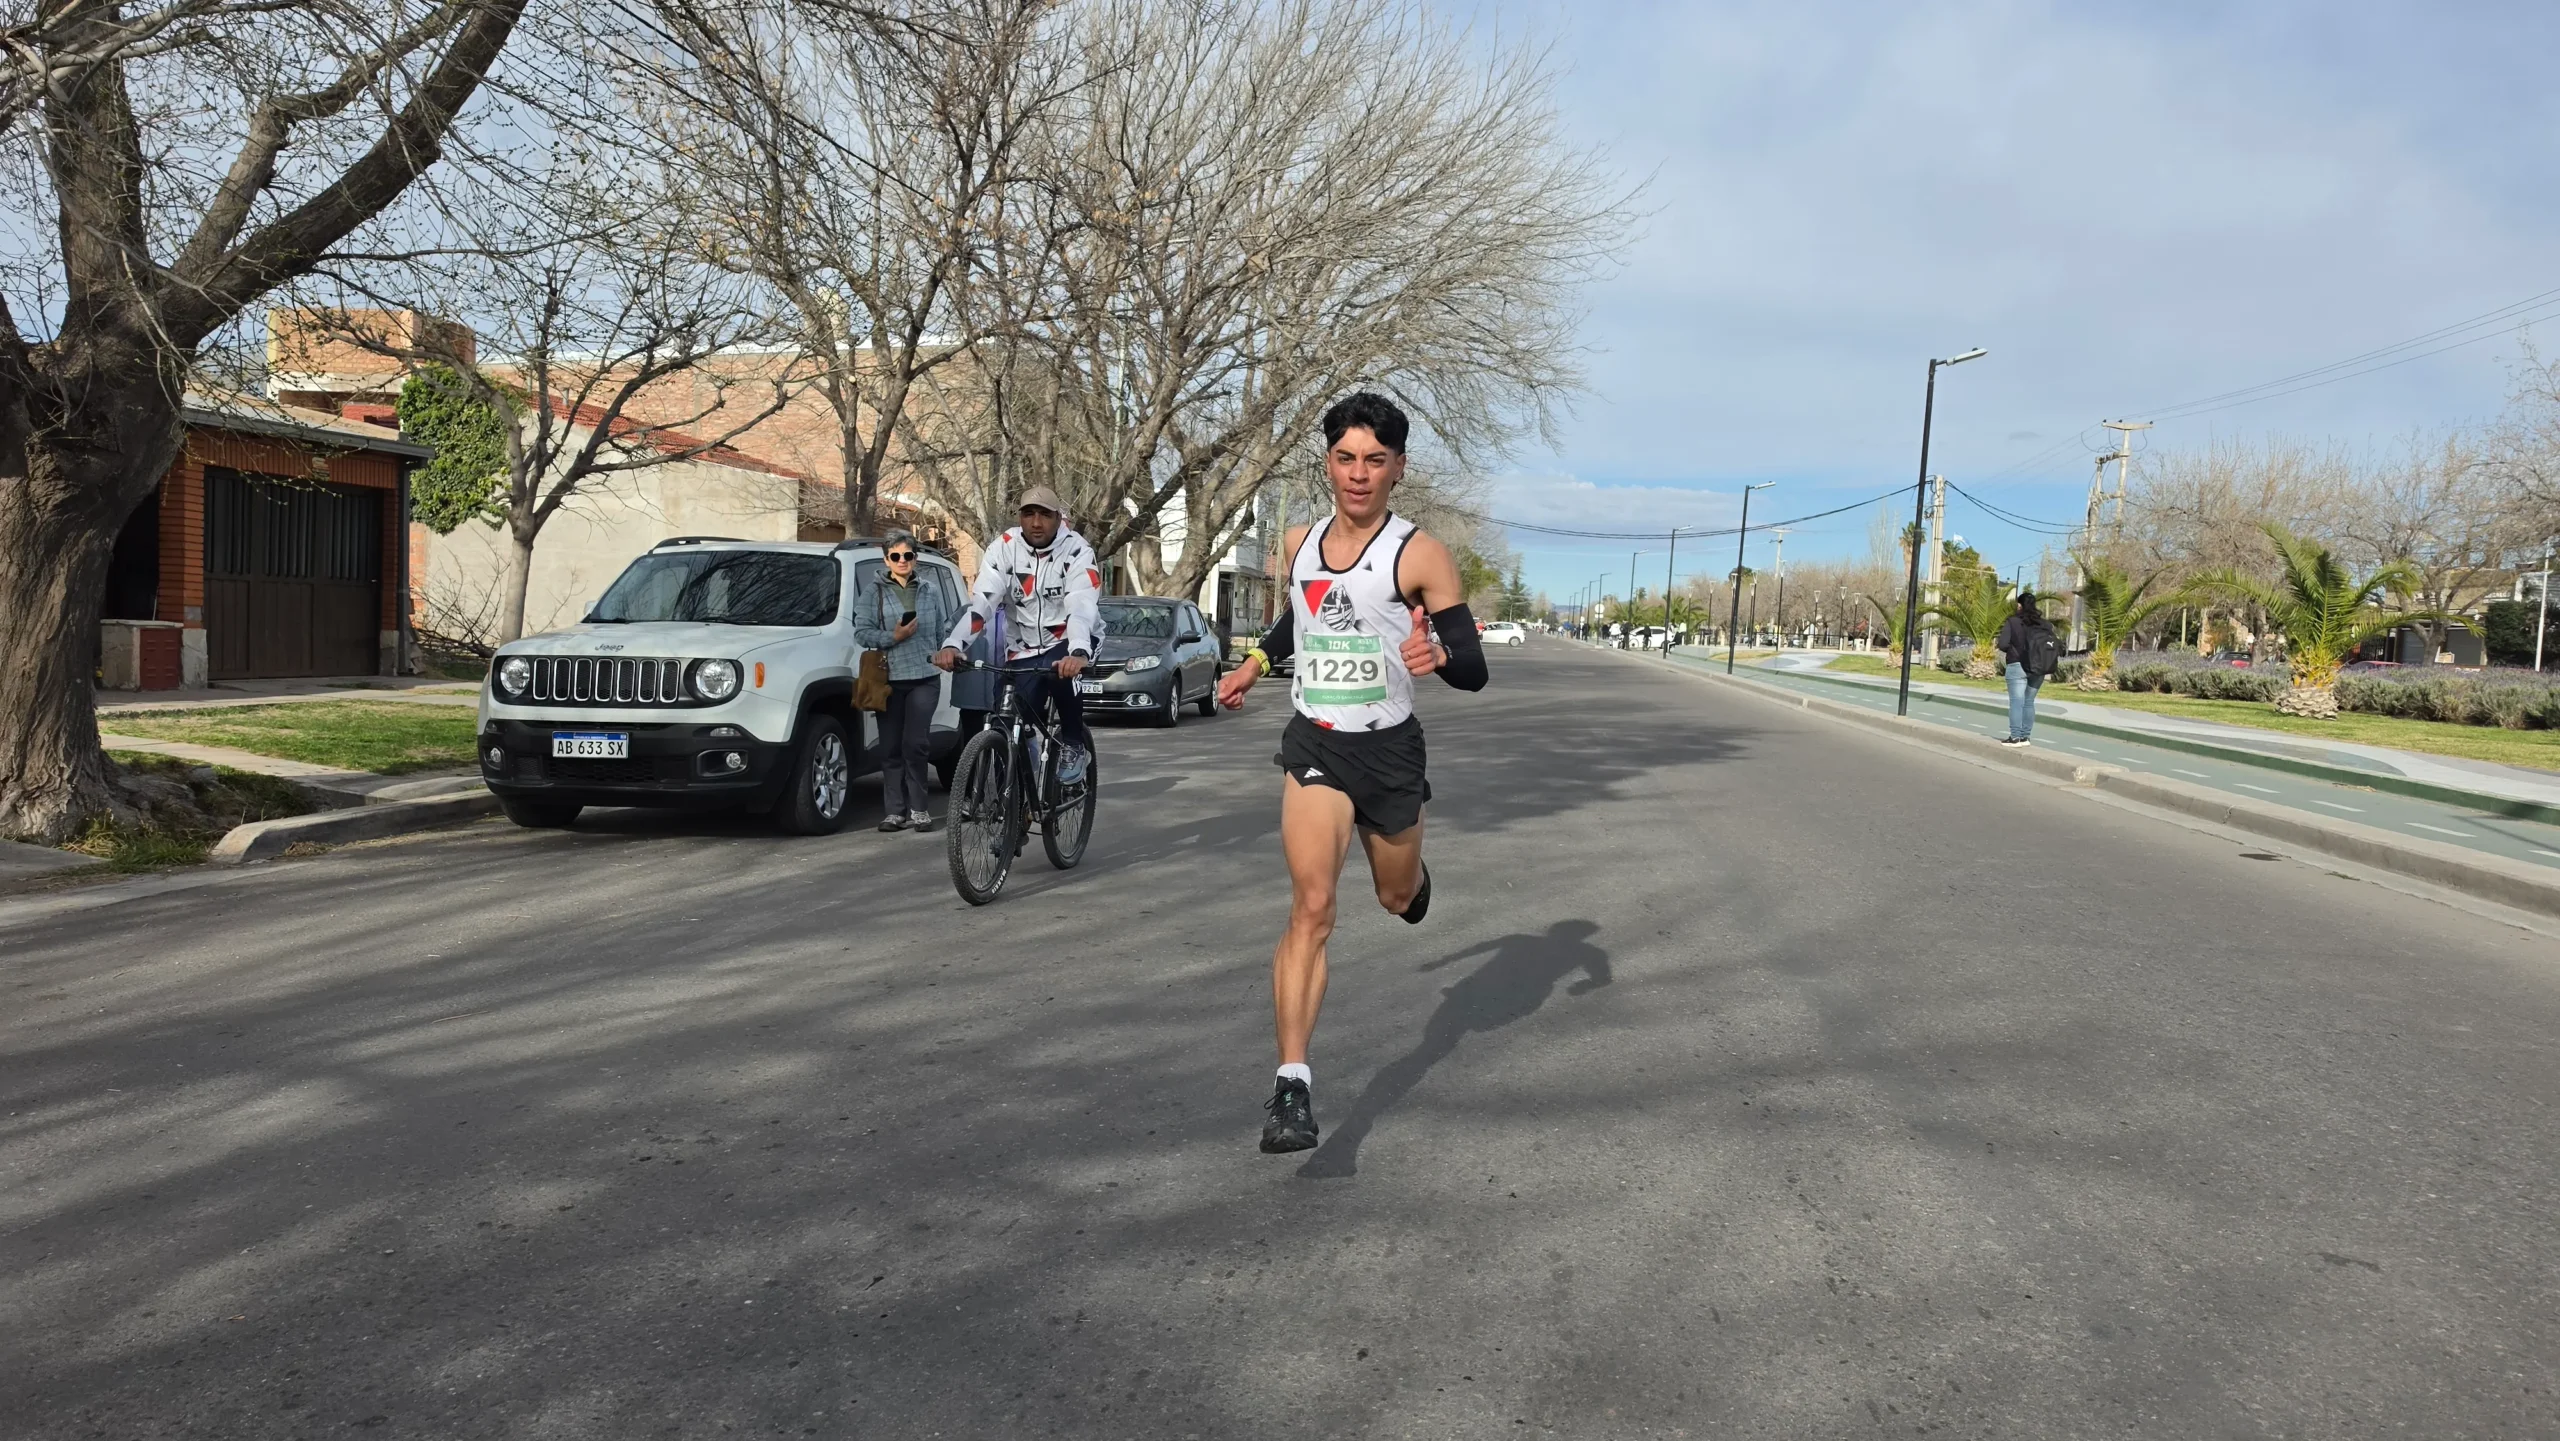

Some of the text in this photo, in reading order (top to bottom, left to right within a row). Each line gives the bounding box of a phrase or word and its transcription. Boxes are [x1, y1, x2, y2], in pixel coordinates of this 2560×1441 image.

[595, 643, 624, 652] Jeep
[1328, 640, 1350, 650] 10K
[1307, 658, 1379, 682] 1229
[557, 740, 624, 755] AB 633 SX
